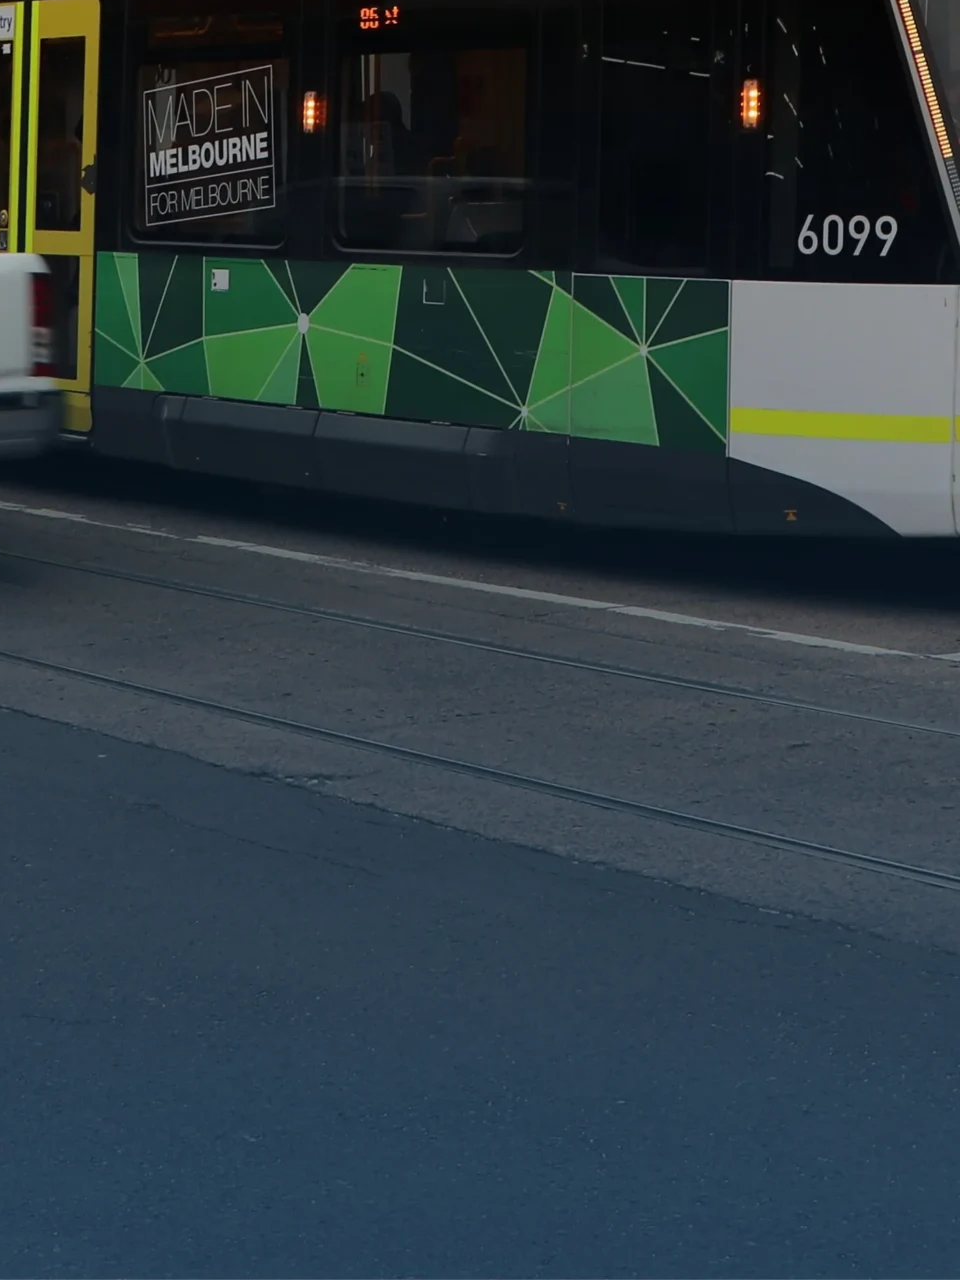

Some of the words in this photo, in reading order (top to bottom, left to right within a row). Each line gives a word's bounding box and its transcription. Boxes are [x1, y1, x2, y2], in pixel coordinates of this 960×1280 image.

[360, 7, 379, 29] 86
[148, 83, 233, 145] MADE
[241, 76, 268, 128] IN
[149, 131, 269, 178] MELBOURNE
[150, 191, 178, 216] FOR
[181, 175, 270, 211] MELBOURNE
[797, 214, 898, 257] 6099
